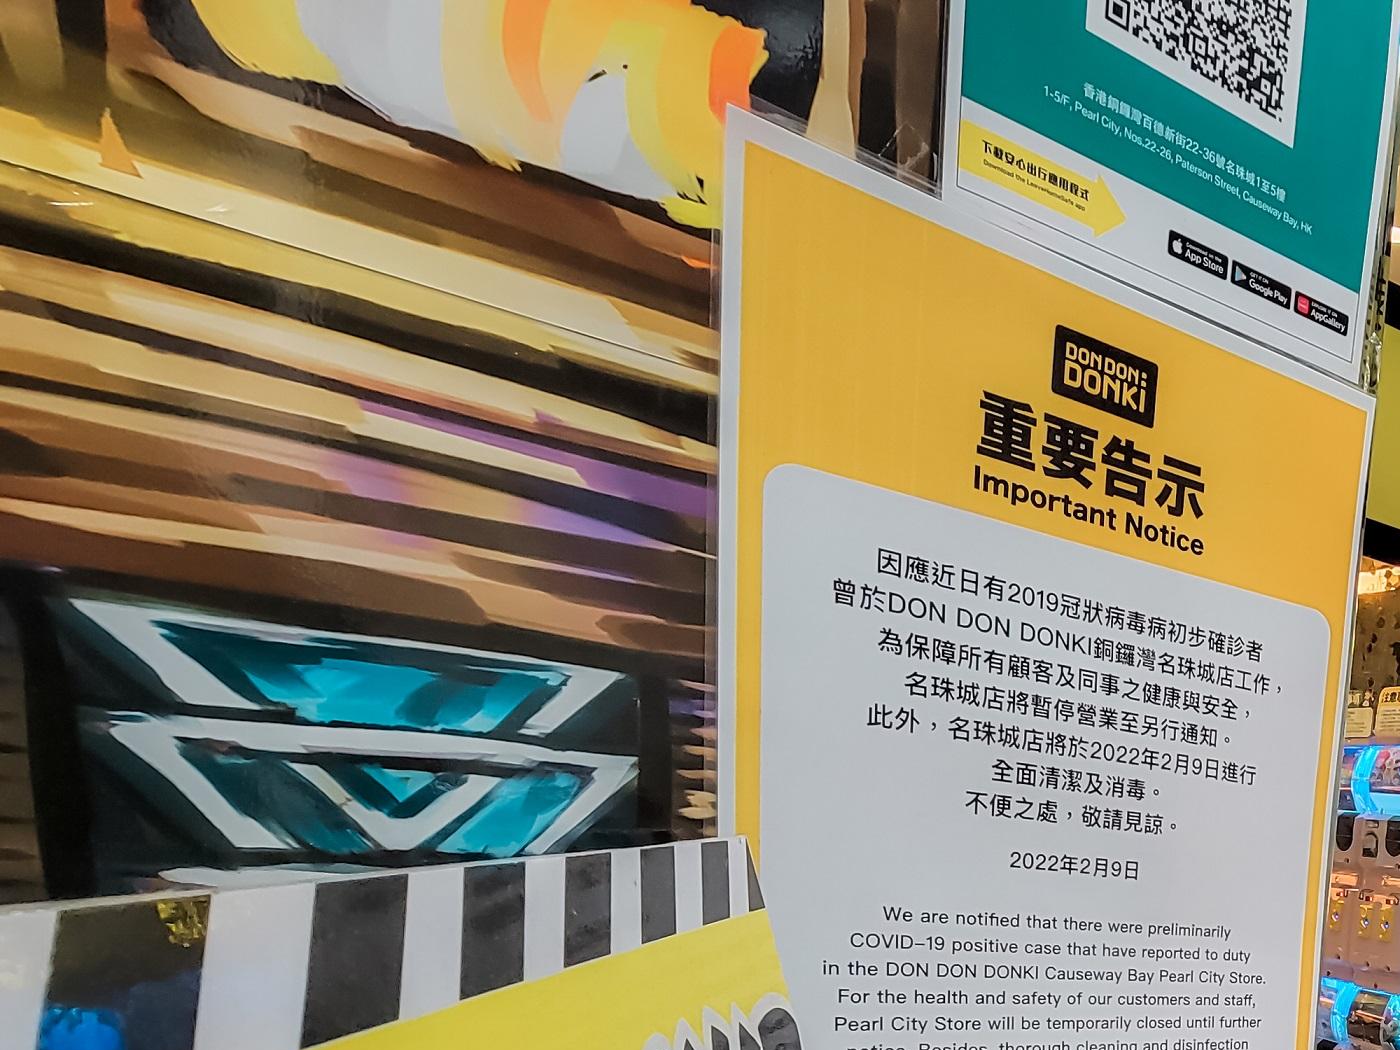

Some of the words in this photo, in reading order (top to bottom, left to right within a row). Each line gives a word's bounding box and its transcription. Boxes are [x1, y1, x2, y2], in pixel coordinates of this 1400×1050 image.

[982, 139, 1089, 202] 下載安心出行應用程式
[1043, 85, 1073, 111] 1-5/F,
[1075, 100, 1100, 124] Pearl
[1101, 113, 1122, 137] City,
[1124, 126, 1174, 163] Nos.22-26,
[1175, 156, 1213, 182] Paterson
[1214, 175, 1241, 199] Street,
[1243, 190, 1282, 220] Causeway
[1282, 212, 1300, 230] Bay,
[1301, 222, 1312, 235] HK
[983, 158, 1014, 178] Download
[1015, 174, 1025, 184] the
[1075, 203, 1086, 211] app
[1185, 249, 1202, 264] App
[1203, 257, 1224, 274] Store
[1249, 278, 1273, 299] Google
[1274, 289, 1288, 305] Play
[1311, 310, 1346, 333] AppGallery
[1065, 341, 1102, 370] DON
[1064, 359, 1146, 413] DONKI
[976, 389, 1205, 519] 重要告示
[973, 464, 1117, 532] Important
[1124, 511, 1205, 556] Notice
[956, 607, 1011, 638] DON
[882, 905, 913, 923] We
[920, 912, 949, 924] are
[956, 911, 1020, 928] notified
[1026, 914, 1058, 930] that
[1063, 916, 1103, 932] there
[1107, 922, 1143, 934] were
[1147, 922, 1232, 942] preliminarily
[951, 938, 1019, 955] positive
[1024, 943, 1062, 955] case
[1066, 941, 1097, 957] that
[1102, 943, 1137, 958] have
[1141, 947, 1201, 962] reported
[1205, 948, 1218, 961] to
[1223, 948, 1251, 965] duty
[822, 959, 840, 976] in
[847, 960, 879, 977] the
[886, 961, 929, 978] DON
[936, 963, 977, 979] DON
[984, 964, 1039, 980] DONKI
[1044, 966, 1123, 985] Causeway
[1128, 968, 1155, 985] Bay
[1159, 969, 1194, 983] Pearl
[1198, 970, 1225, 987] City
[1229, 971, 1266, 985] Store.
[838, 988, 871, 1004] For
[876, 988, 907, 1005] the
[914, 989, 968, 1005] health
[975, 990, 1006, 1005] and
[1012, 991, 1062, 1009] safety
[1067, 991, 1083, 1005] of
[1088, 995, 1113, 1005] our
[1117, 993, 1191, 1006] customers
[1195, 993, 1220, 1006] and
[1223, 993, 1256, 1007] staff,
[834, 1016, 883, 1032] Pearl
[891, 1016, 928, 1035] City
[934, 1016, 982, 1031] Store
[987, 1016, 1015, 1031] will
[1021, 1016, 1041, 1030] be
[1046, 1015, 1132, 1033] temporarily
[1136, 1015, 1182, 1029] closed
[1186, 1015, 1215, 1029] until
[1219, 1015, 1262, 1029] further
